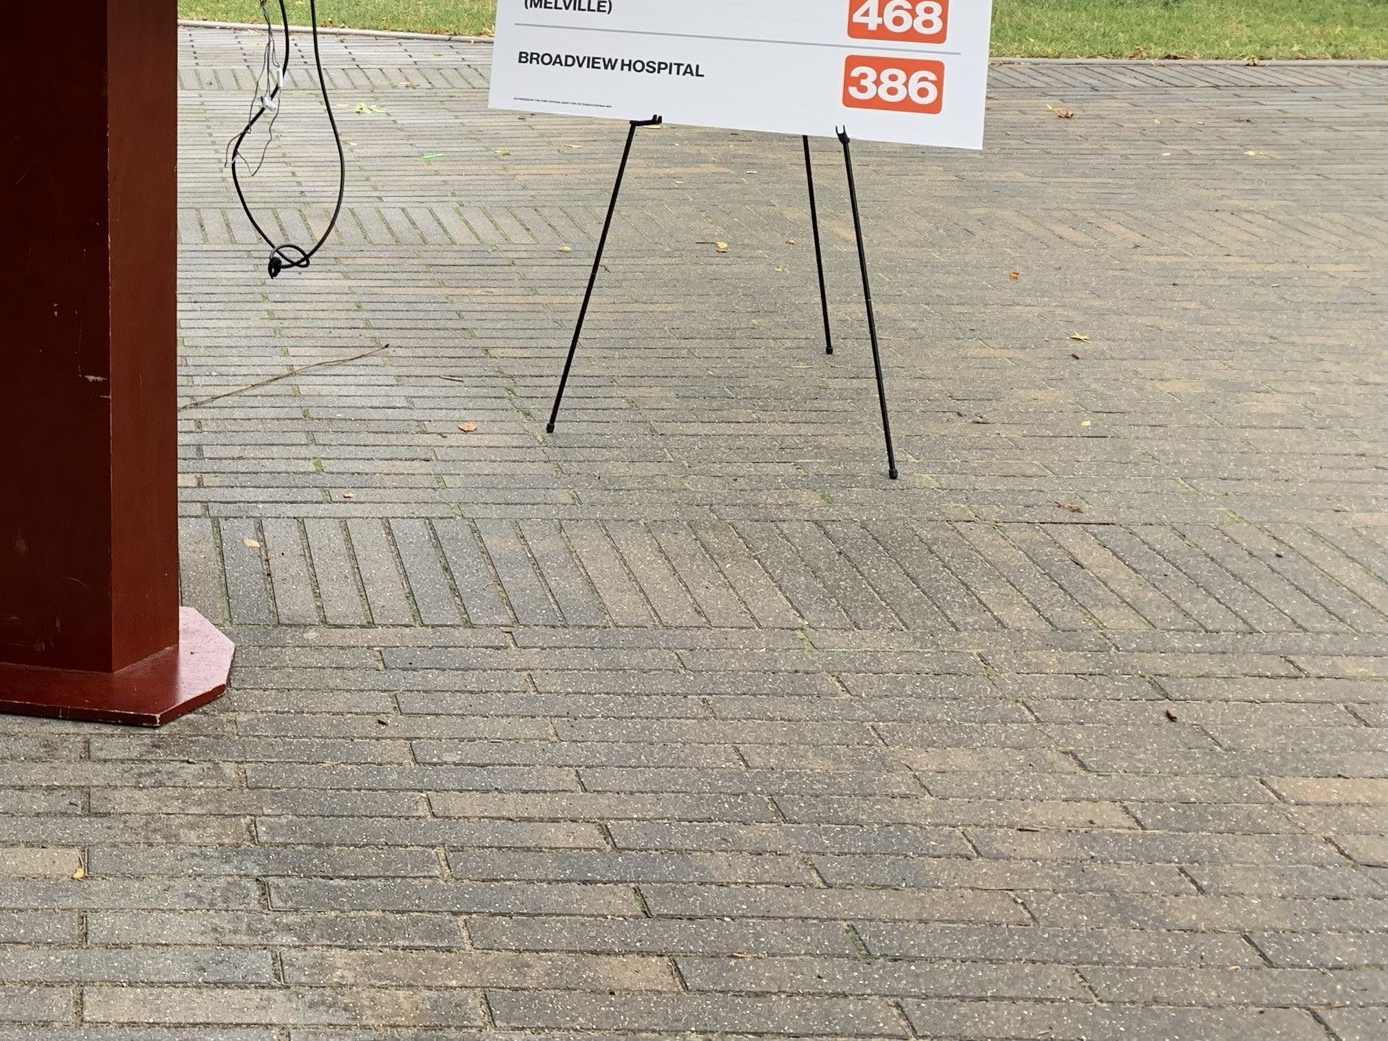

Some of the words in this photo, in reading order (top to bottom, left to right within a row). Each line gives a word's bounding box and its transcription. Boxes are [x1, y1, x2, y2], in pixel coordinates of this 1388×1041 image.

[518, 52, 618, 70] BROADVIEW
[621, 59, 704, 77] HOSPITAL
[849, 66, 937, 104] 386
